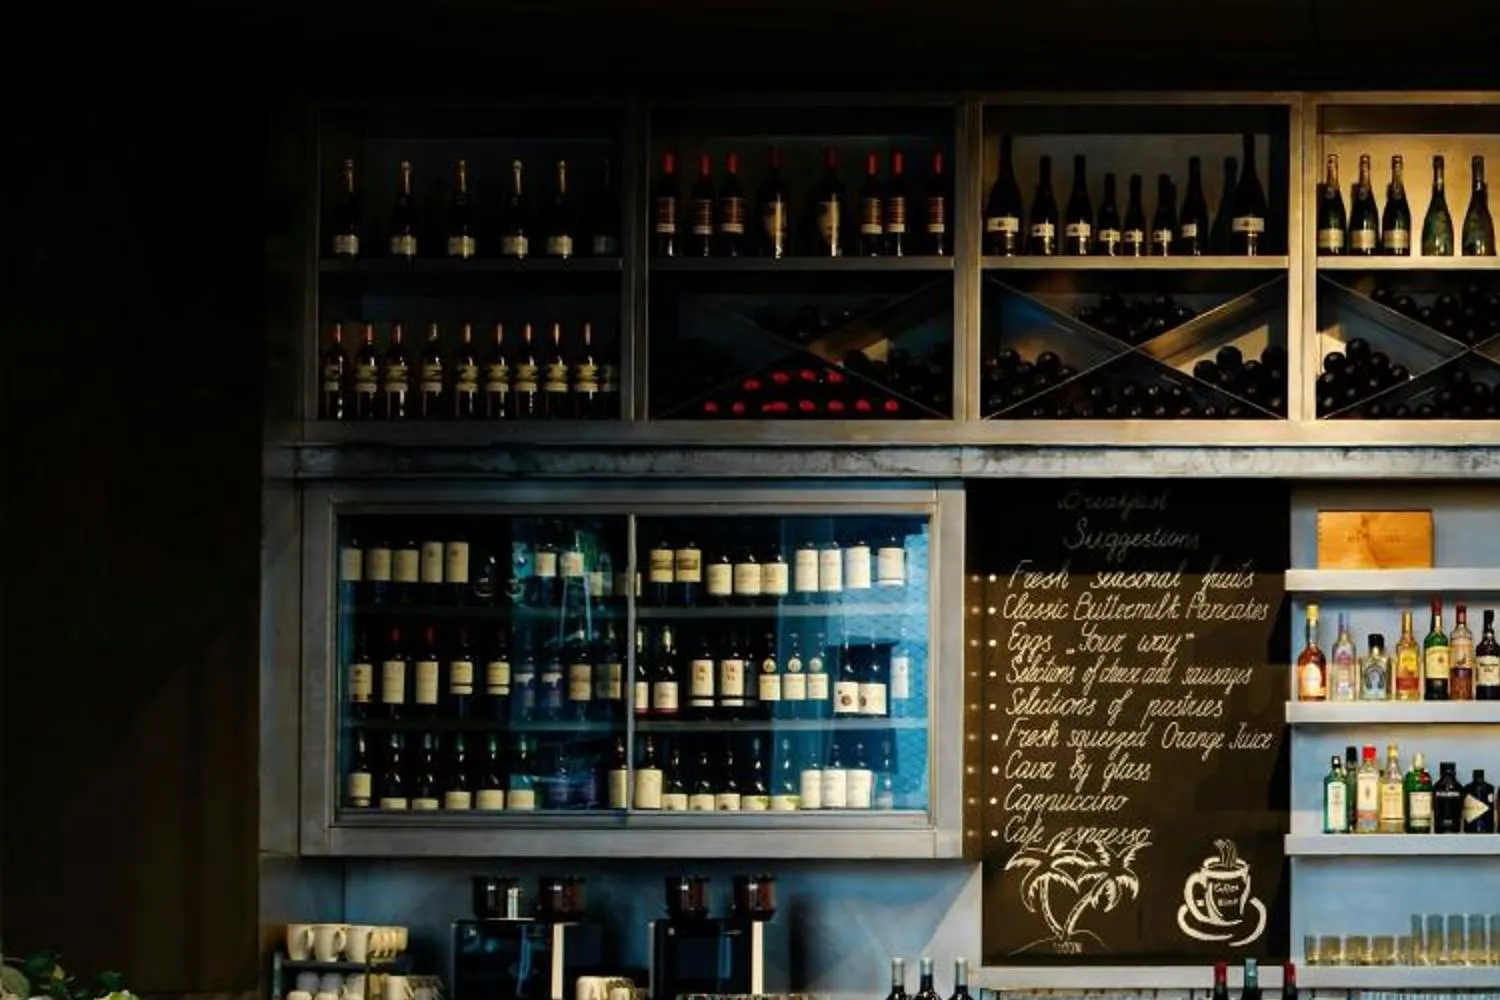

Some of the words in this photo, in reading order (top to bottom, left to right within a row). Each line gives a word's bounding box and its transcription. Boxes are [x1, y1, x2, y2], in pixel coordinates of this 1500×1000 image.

[1062, 515, 1200, 563] Suggestions
[1008, 558, 1070, 589] Fresh
[1089, 559, 1187, 589] seasonal
[1003, 592, 1069, 620] Classic
[1073, 591, 1181, 621] Buttermilk
[1185, 591, 1269, 621] Pancakes
[1007, 621, 1053, 662] Eggs
[1005, 653, 1077, 684] Selections
[1081, 654, 1106, 695] of
[1141, 657, 1178, 684] and
[1181, 667, 1253, 695] sausages
[1005, 687, 1097, 716] Selections
[1107, 688, 1133, 726] of
[1141, 690, 1224, 727] pastries
[1004, 718, 1060, 748] Fresh
[1066, 722, 1153, 761] squeezed
[1160, 721, 1225, 761] Orange
[1228, 722, 1273, 749] Juice
[1004, 749, 1056, 780] Cava
[1069, 749, 1094, 792] by
[1102, 752, 1153, 792] glass
[1003, 783, 1131, 822] Cappuccino
